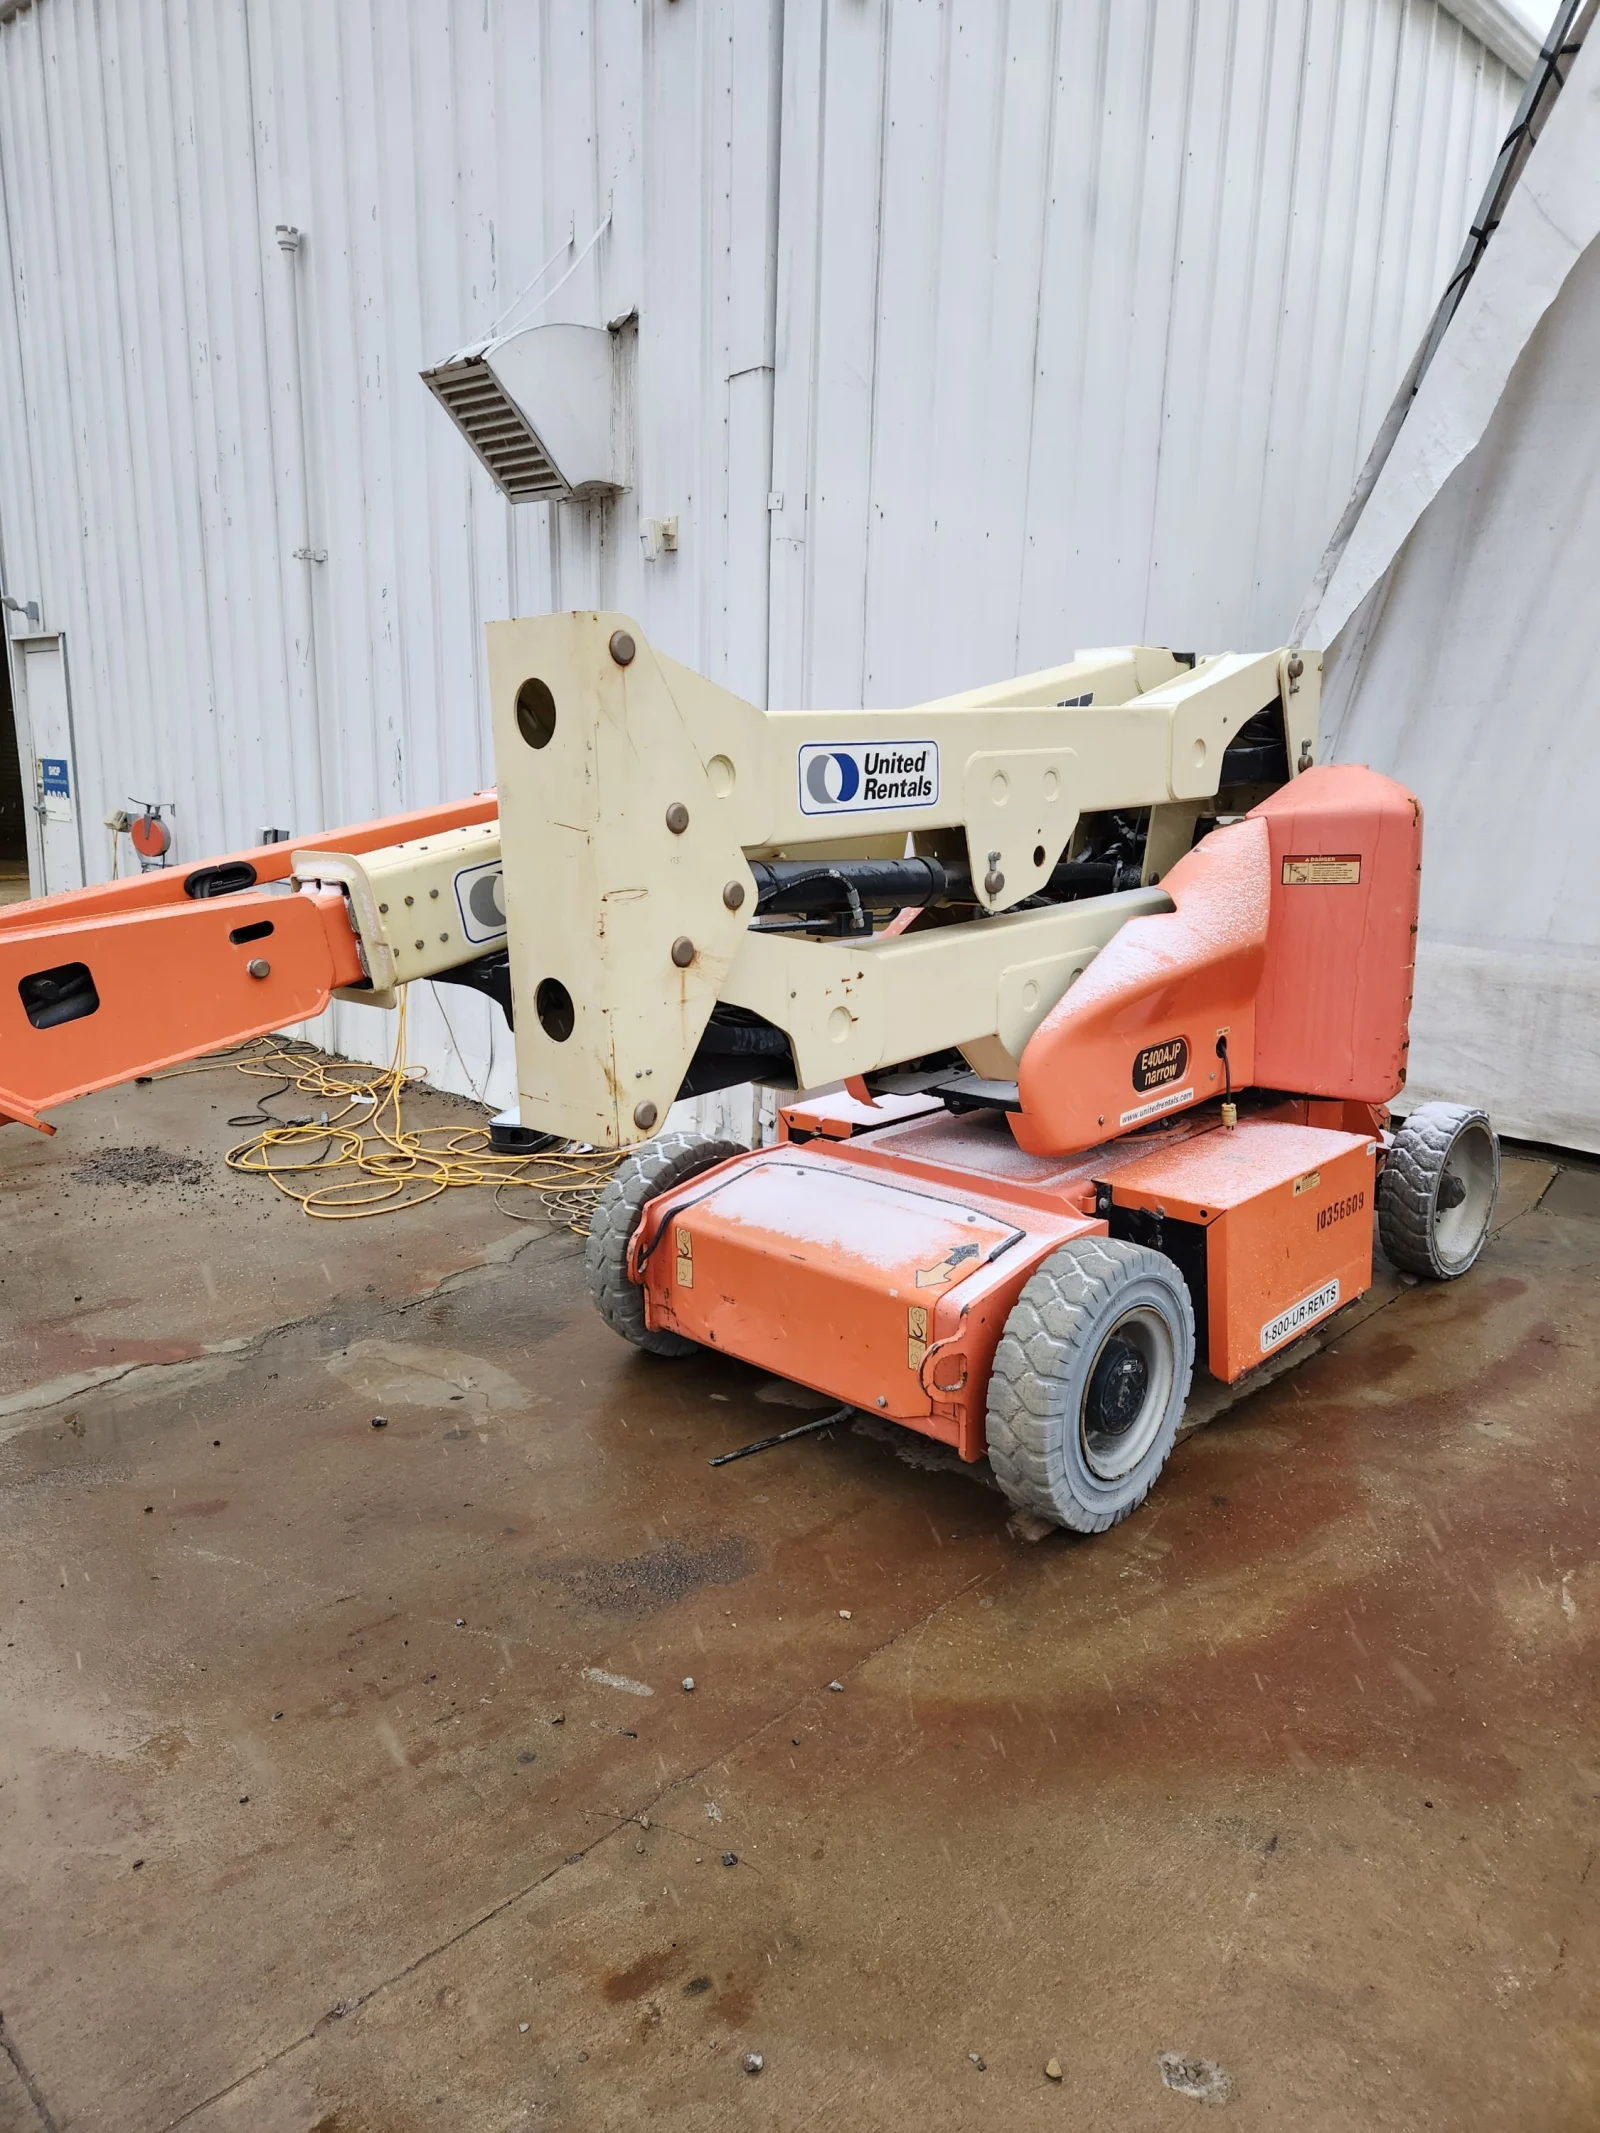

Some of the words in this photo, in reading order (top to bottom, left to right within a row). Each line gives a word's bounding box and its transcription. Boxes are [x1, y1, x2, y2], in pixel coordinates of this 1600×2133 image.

[864, 751, 927, 775] United
[864, 775, 932, 800] Rentals
[1141, 1042, 1181, 1071] E400AJP
[1144, 1063, 1178, 1086] narrow
[1121, 1090, 1193, 1124] www.unitedrentals.com
[1263, 1285, 1337, 1345] 1-800-UR-RENTS
